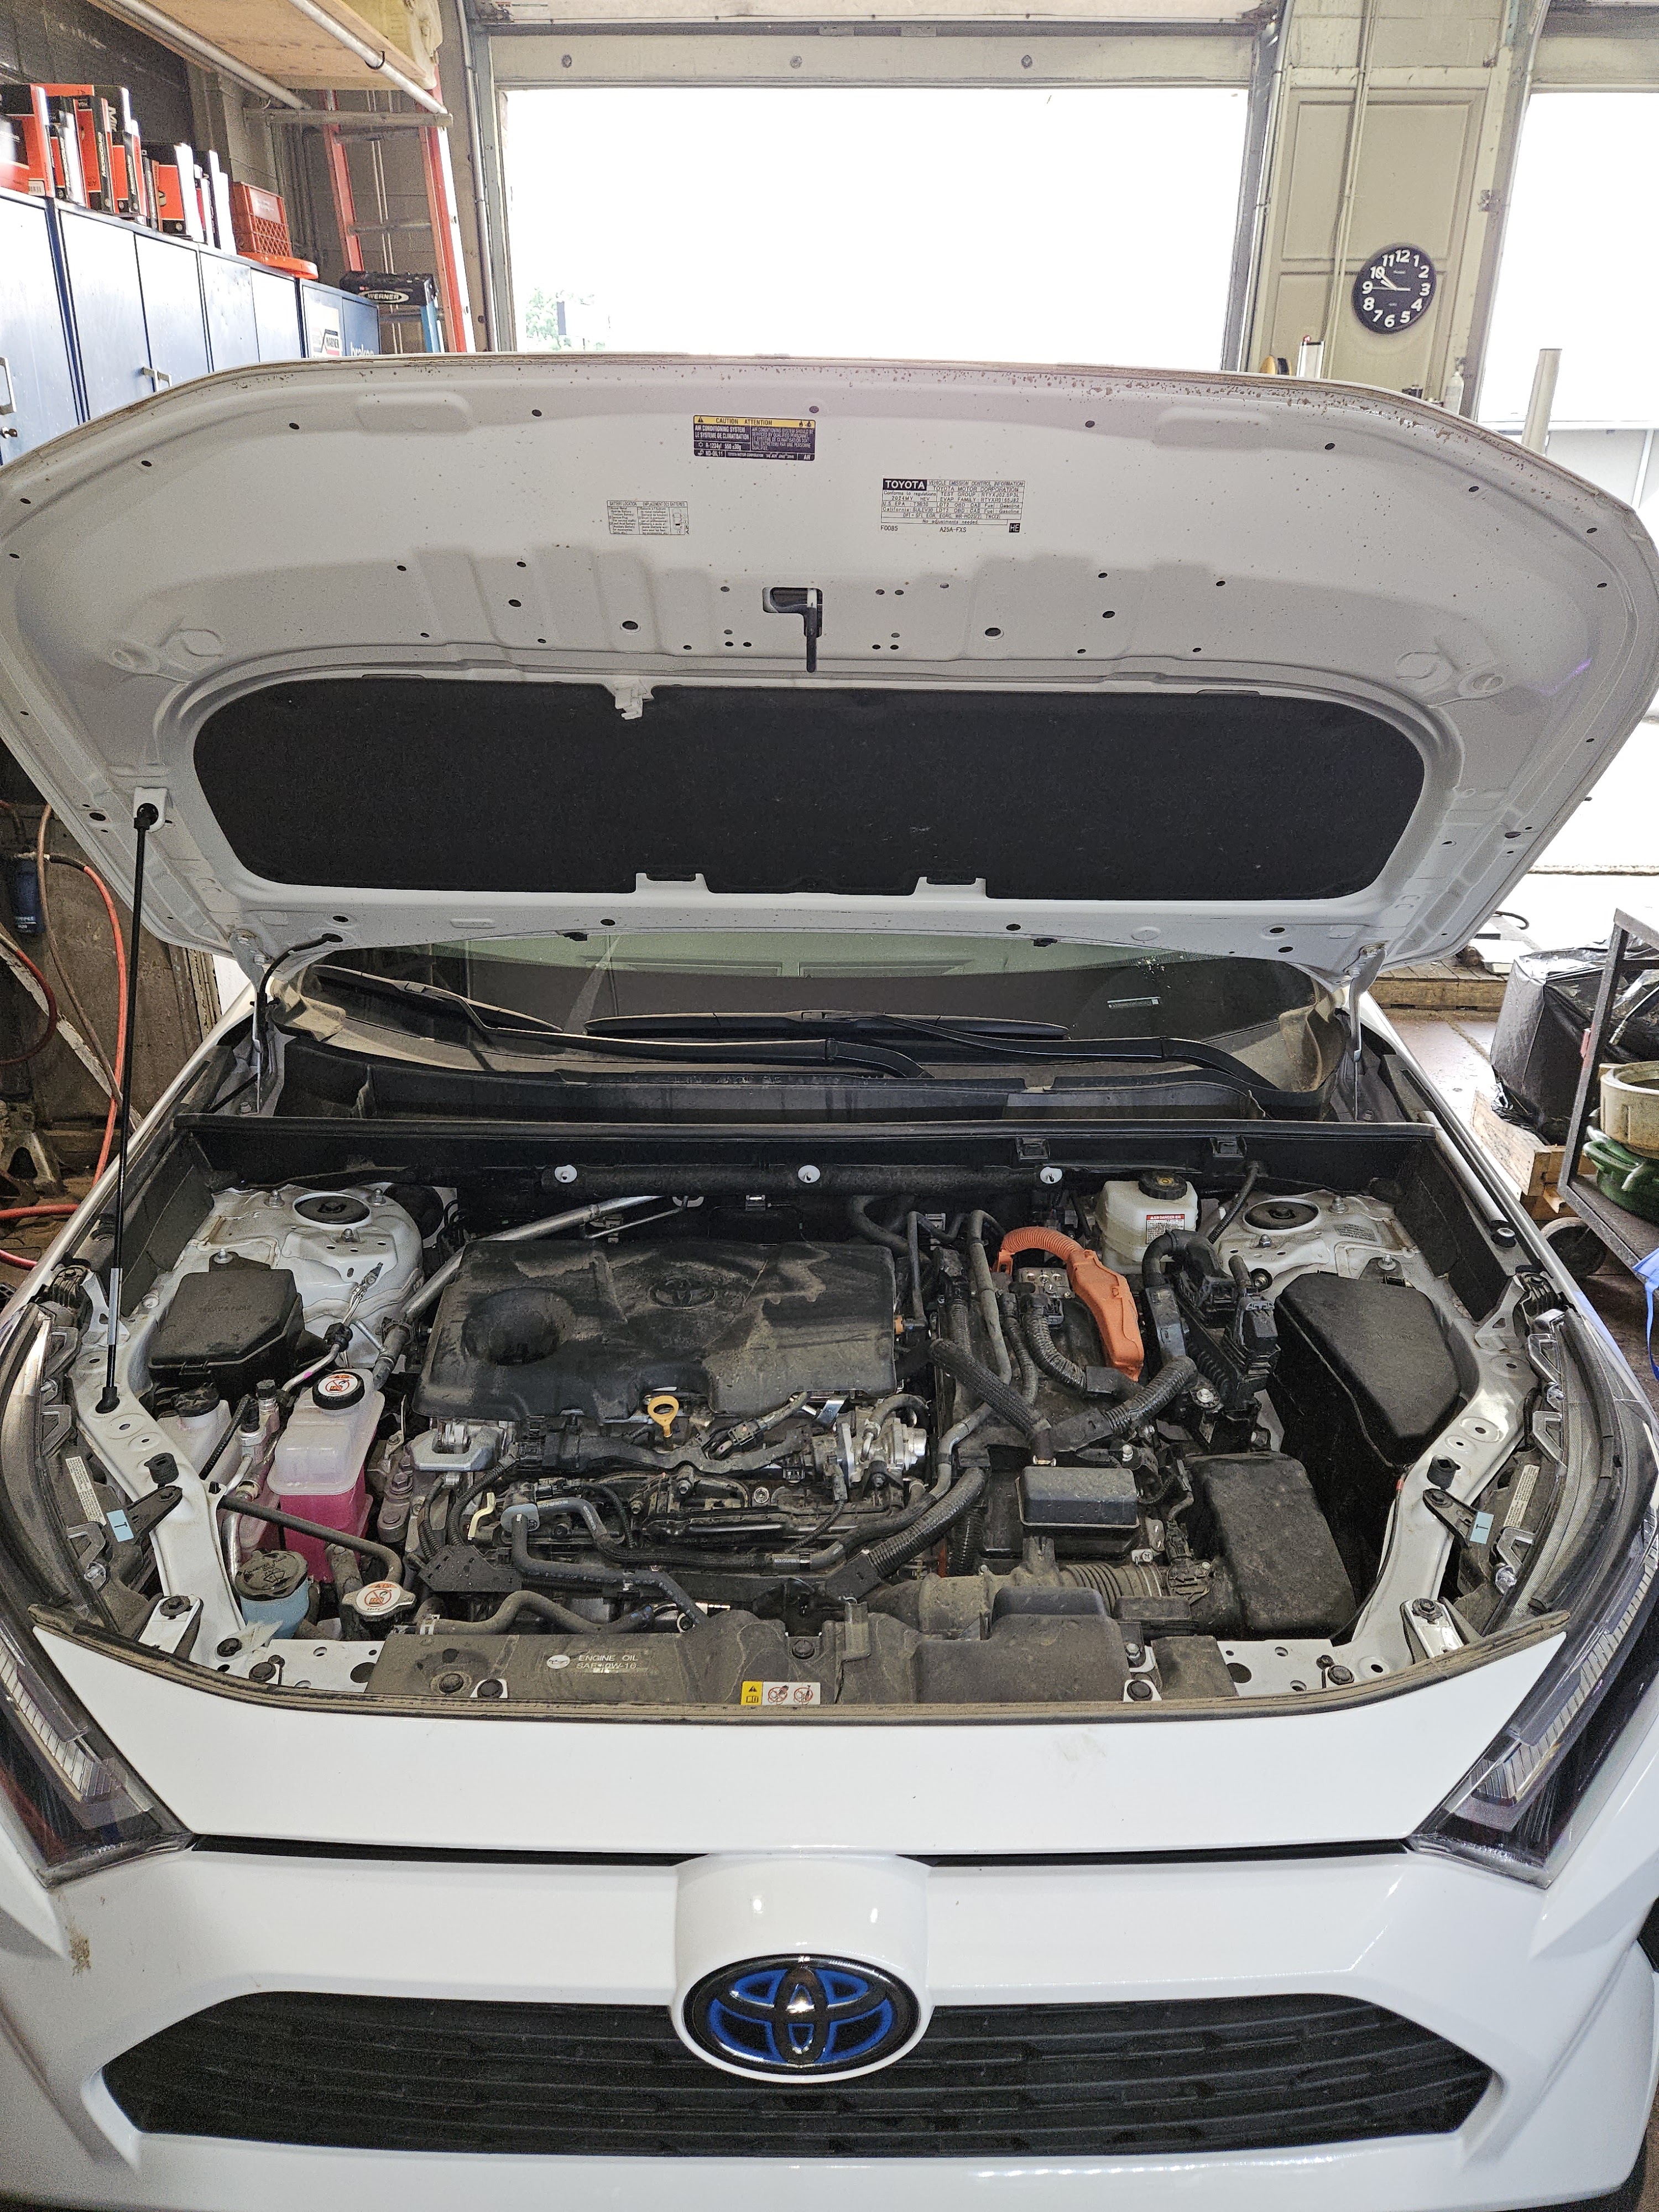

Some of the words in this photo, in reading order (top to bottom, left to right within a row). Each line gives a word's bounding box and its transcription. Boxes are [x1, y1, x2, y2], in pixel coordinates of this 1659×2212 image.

[97, 132, 107, 178] MICROGARD
[1383, 254, 1395, 267] 11
[1395, 250, 1411, 263] 12
[1413, 255, 1420, 267] 1
[1370, 266, 1385, 279] 10
[1418, 265, 1430, 279] 2
[1362, 280, 1373, 294] 9
[1420, 283, 1431, 296] 3
[368, 293, 400, 301] WERNER
[1363, 297, 1375, 311] 8
[1411, 298, 1423, 311] 4
[1373, 310, 1384, 322] 7
[1384, 314, 1395, 328] 6
[1400, 311, 1411, 324] 5
[885, 480, 925, 489] TOYOTA
